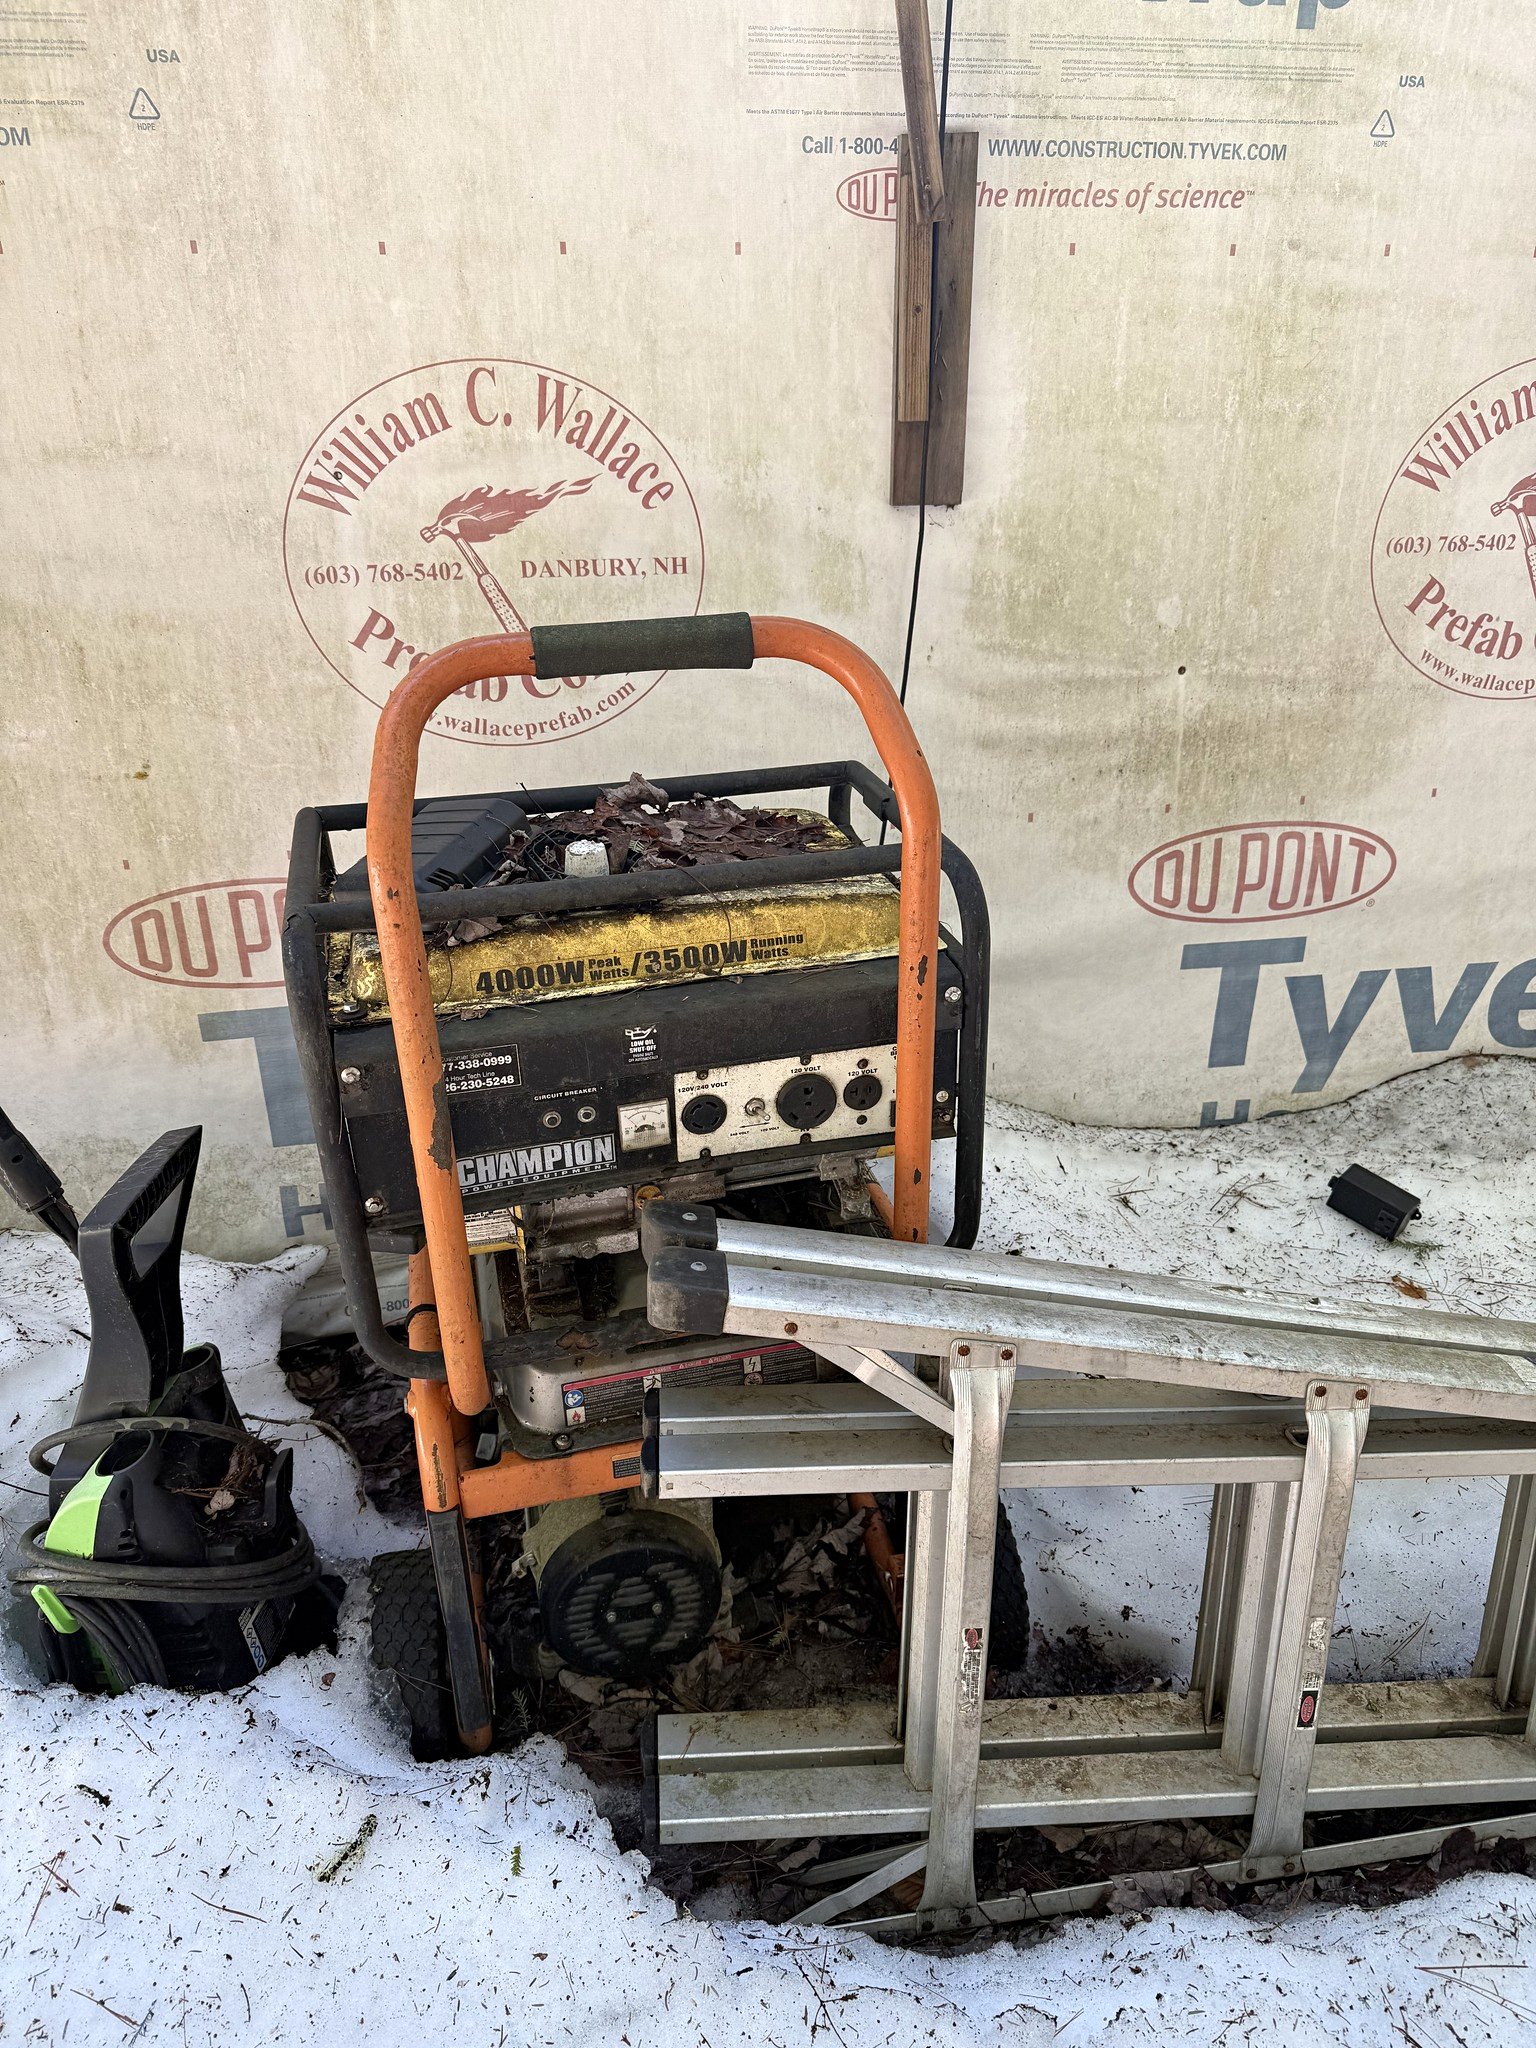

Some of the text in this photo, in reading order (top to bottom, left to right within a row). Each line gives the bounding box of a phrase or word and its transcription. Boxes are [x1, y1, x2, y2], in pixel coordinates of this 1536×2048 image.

[146, 49, 181, 63] USA
[1399, 75, 1425, 88] USA
[137, 123, 156, 131] HDPE
[802, 136, 1287, 162] Call 1-800-4 WWW.CONSTRUCTION.TYVEK.COM
[1014, 181, 1120, 208] miracles
[1125, 182, 1154, 214] of
[296, 366, 674, 516] William C. Wallace
[1386, 534, 1516, 558] (603) 768-5402
[304, 556, 688, 590] (603) 768-5402 DANBURY, NH
[1404, 574, 1523, 660] Prefab
[1421, 648, 1536, 695] www.wallacep
[1153, 830, 1377, 914] DUPONT
[476, 960, 585, 994] 4000W
[588, 955, 622, 969] Peak
[750, 932, 804, 950] Running
[750, 946, 789, 960] Watts
[589, 966, 630, 980] Watts
[1180, 936, 1536, 1094] Tyve
[442, 1051, 492, 1062] ustomer Service
[442, 1054, 512, 1072] 77-338-0999
[446, 1074, 514, 1092] 26-230-5248
[534, 1086, 598, 1100] CIRCUIT BREAKER
[456, 1136, 613, 1186] CHAMPION
[462, 1164, 611, 1194] POWER EQUIPMENT
